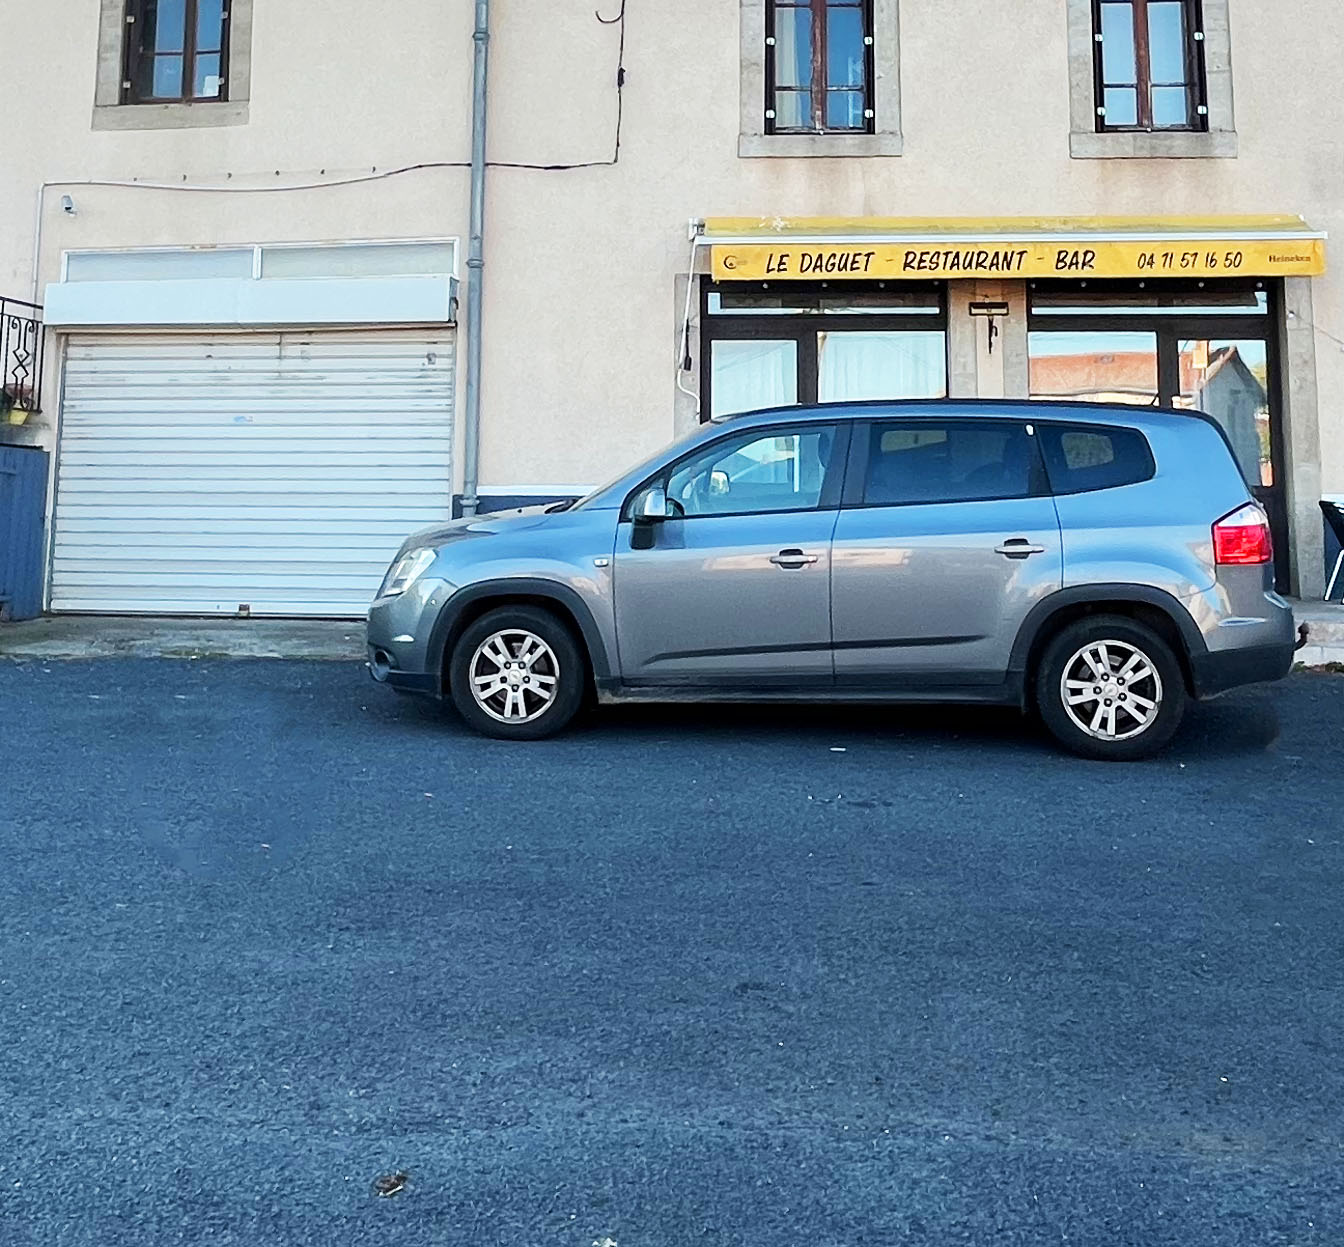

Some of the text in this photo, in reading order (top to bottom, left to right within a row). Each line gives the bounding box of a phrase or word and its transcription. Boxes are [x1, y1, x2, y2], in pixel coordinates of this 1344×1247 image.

[766, 253, 790, 274] LE
[799, 251, 875, 273] DAGUET
[902, 250, 1028, 272] RESTAURANT
[1055, 249, 1096, 271] BAR
[1137, 251, 1243, 269] 04 71 57 16 50
[1268, 254, 1311, 263] Heineken
